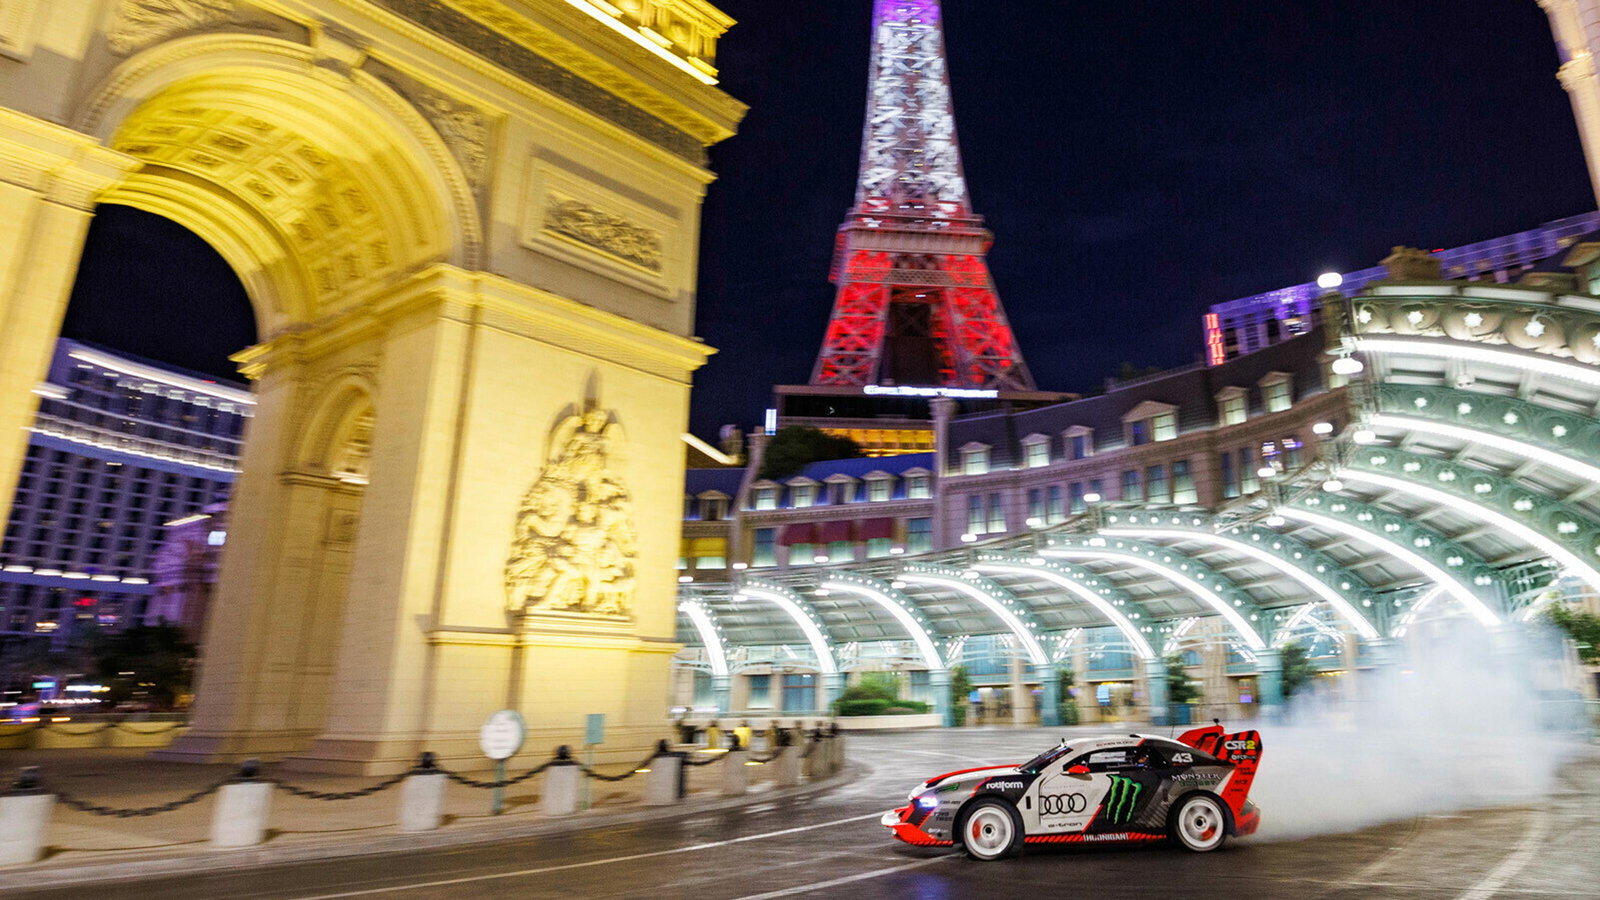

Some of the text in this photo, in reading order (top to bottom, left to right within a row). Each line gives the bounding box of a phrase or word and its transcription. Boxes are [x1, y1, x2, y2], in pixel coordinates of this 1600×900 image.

[1224, 740, 1256, 750] CSR2
[1171, 752, 1194, 763] 43
[1171, 773, 1221, 782] MONSTER
[986, 780, 1024, 792] rotiform
